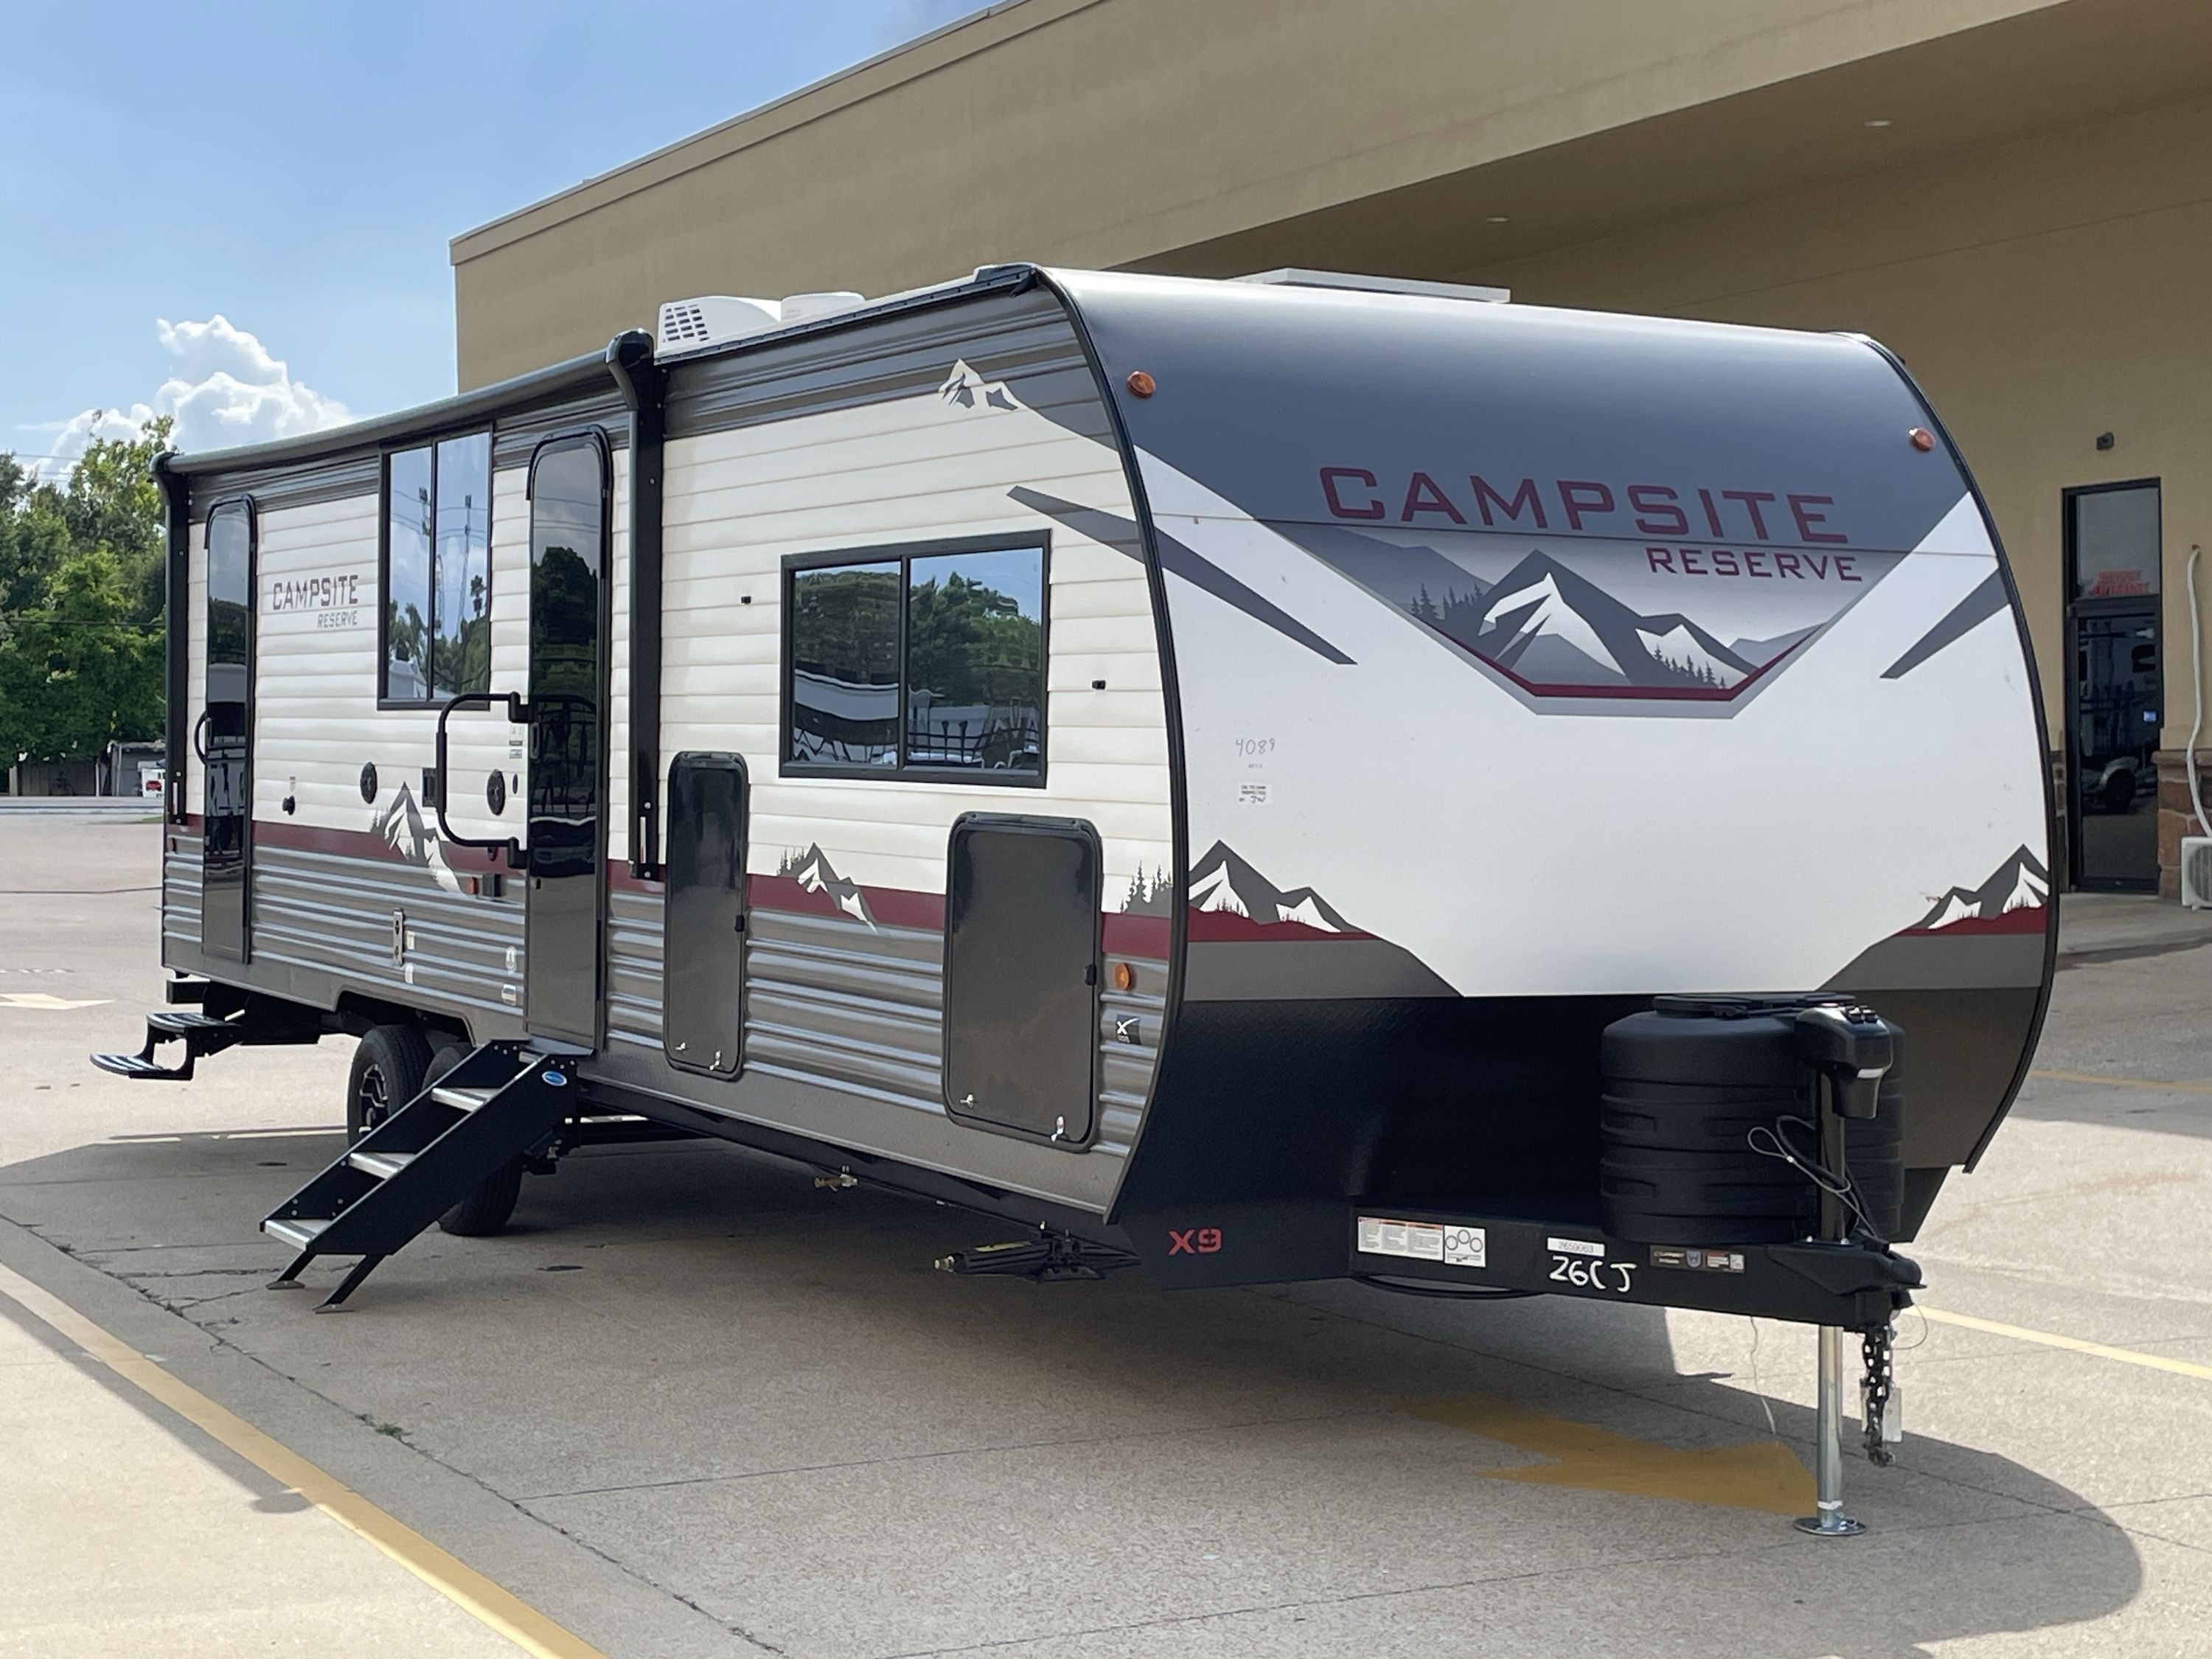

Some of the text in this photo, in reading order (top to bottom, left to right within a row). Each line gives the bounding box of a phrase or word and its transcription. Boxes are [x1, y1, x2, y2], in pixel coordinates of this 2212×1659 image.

[1319, 466, 1849, 544] CAMPSITE
[1646, 546, 1863, 582] RESERVE
[273, 575, 358, 611] CAMPSITE
[317, 611, 358, 628] RESERVE
[1235, 737, 1276, 757] 4089
[1168, 1228, 1222, 1256] X9
